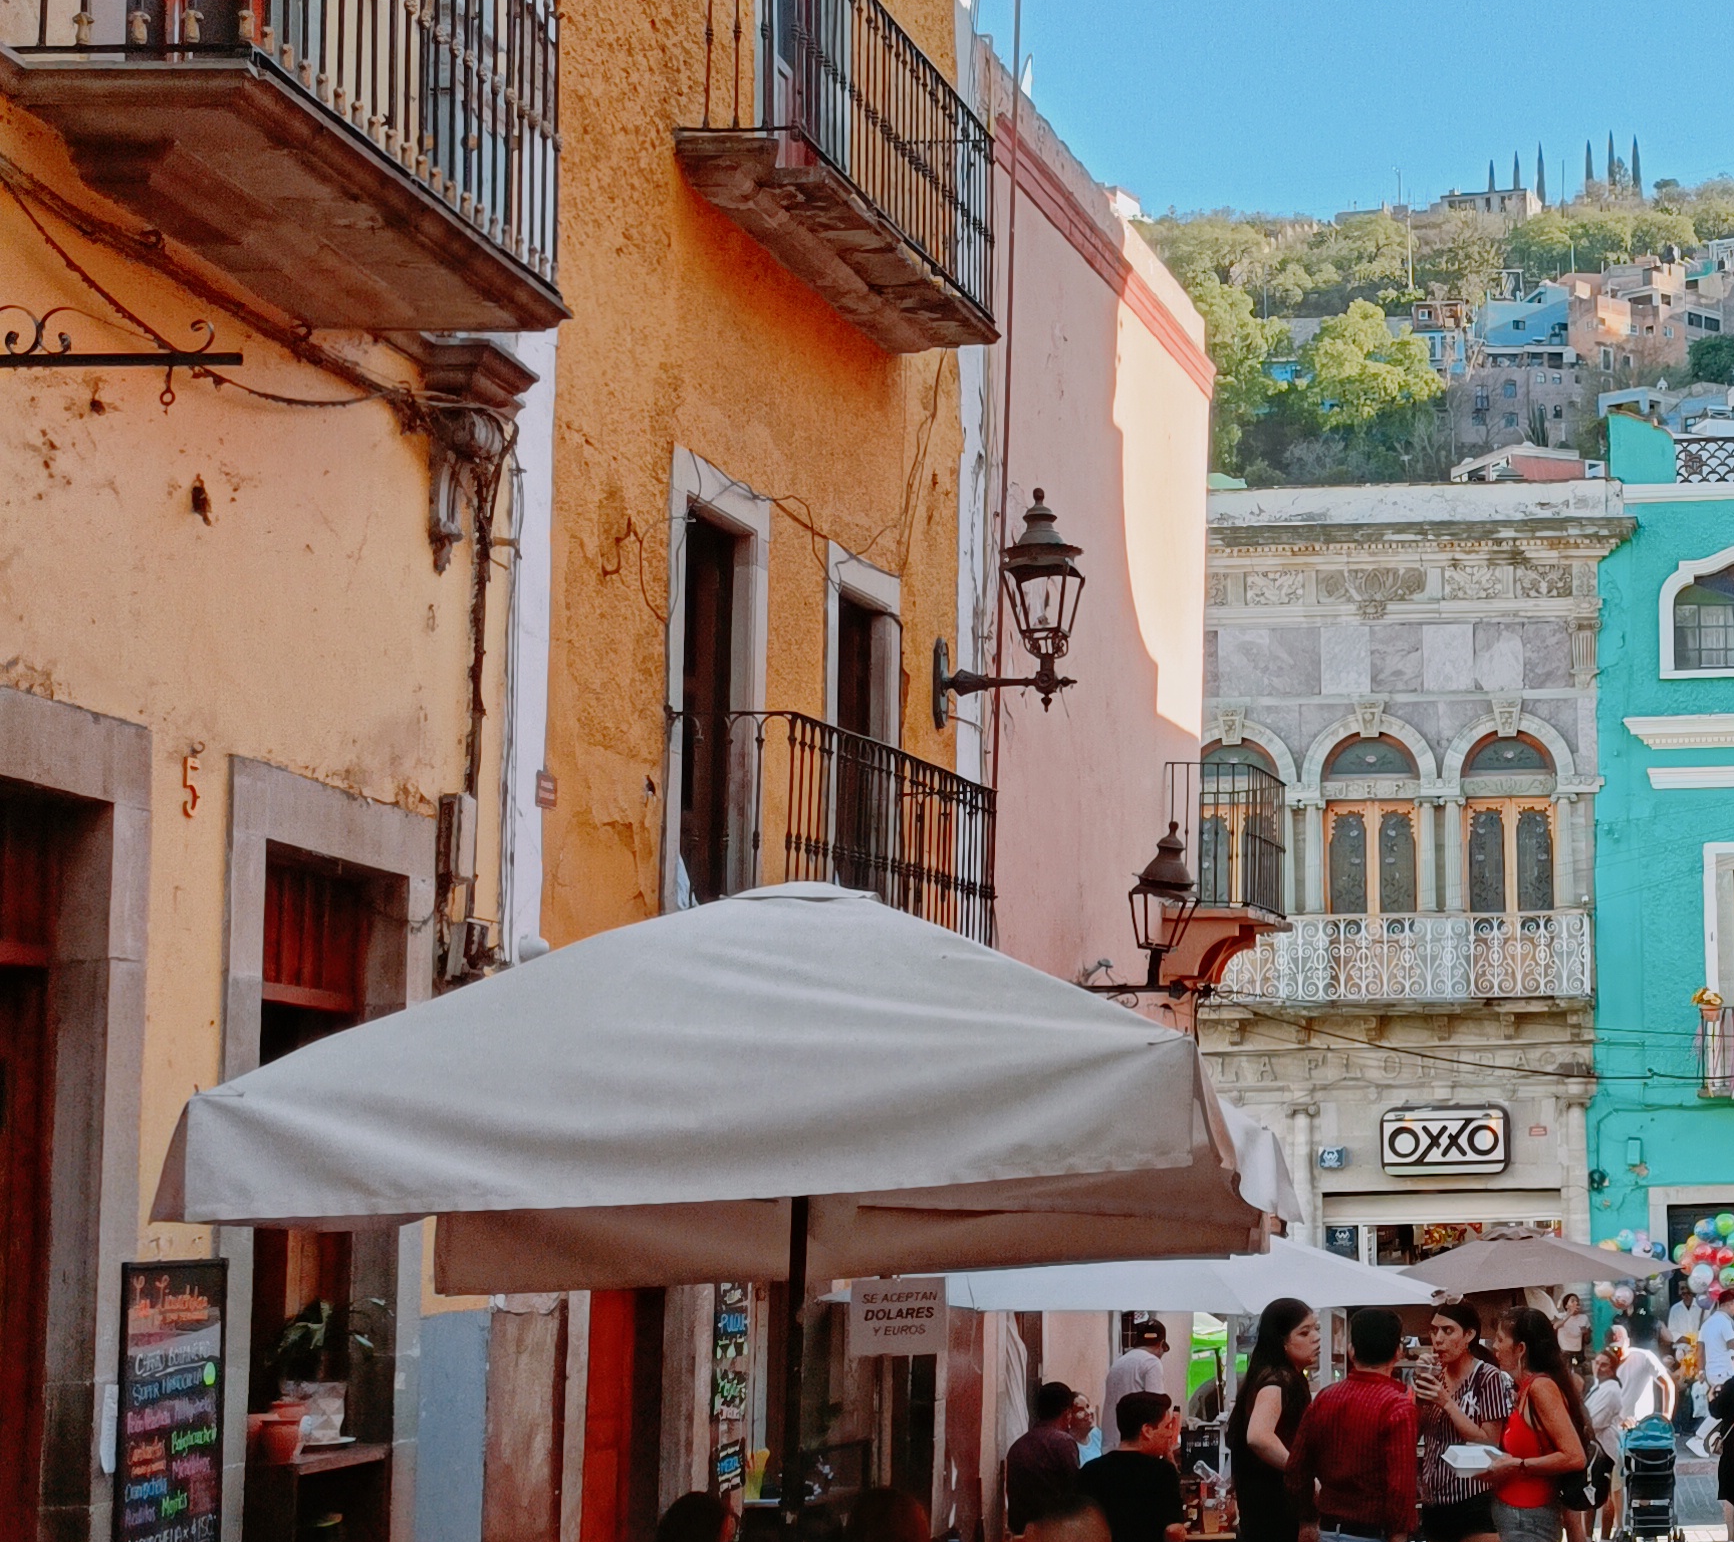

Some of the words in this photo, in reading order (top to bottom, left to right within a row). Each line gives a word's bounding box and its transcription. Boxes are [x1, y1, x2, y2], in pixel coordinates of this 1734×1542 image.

[1388, 1121, 1500, 1161] OXXO
[862, 1293, 879, 1304] SE
[881, 1291, 938, 1304] ACEPTAN
[863, 1306, 935, 1322] DOLARES
[873, 1326, 882, 1336] Y
[883, 1324, 926, 1336] EUROS
